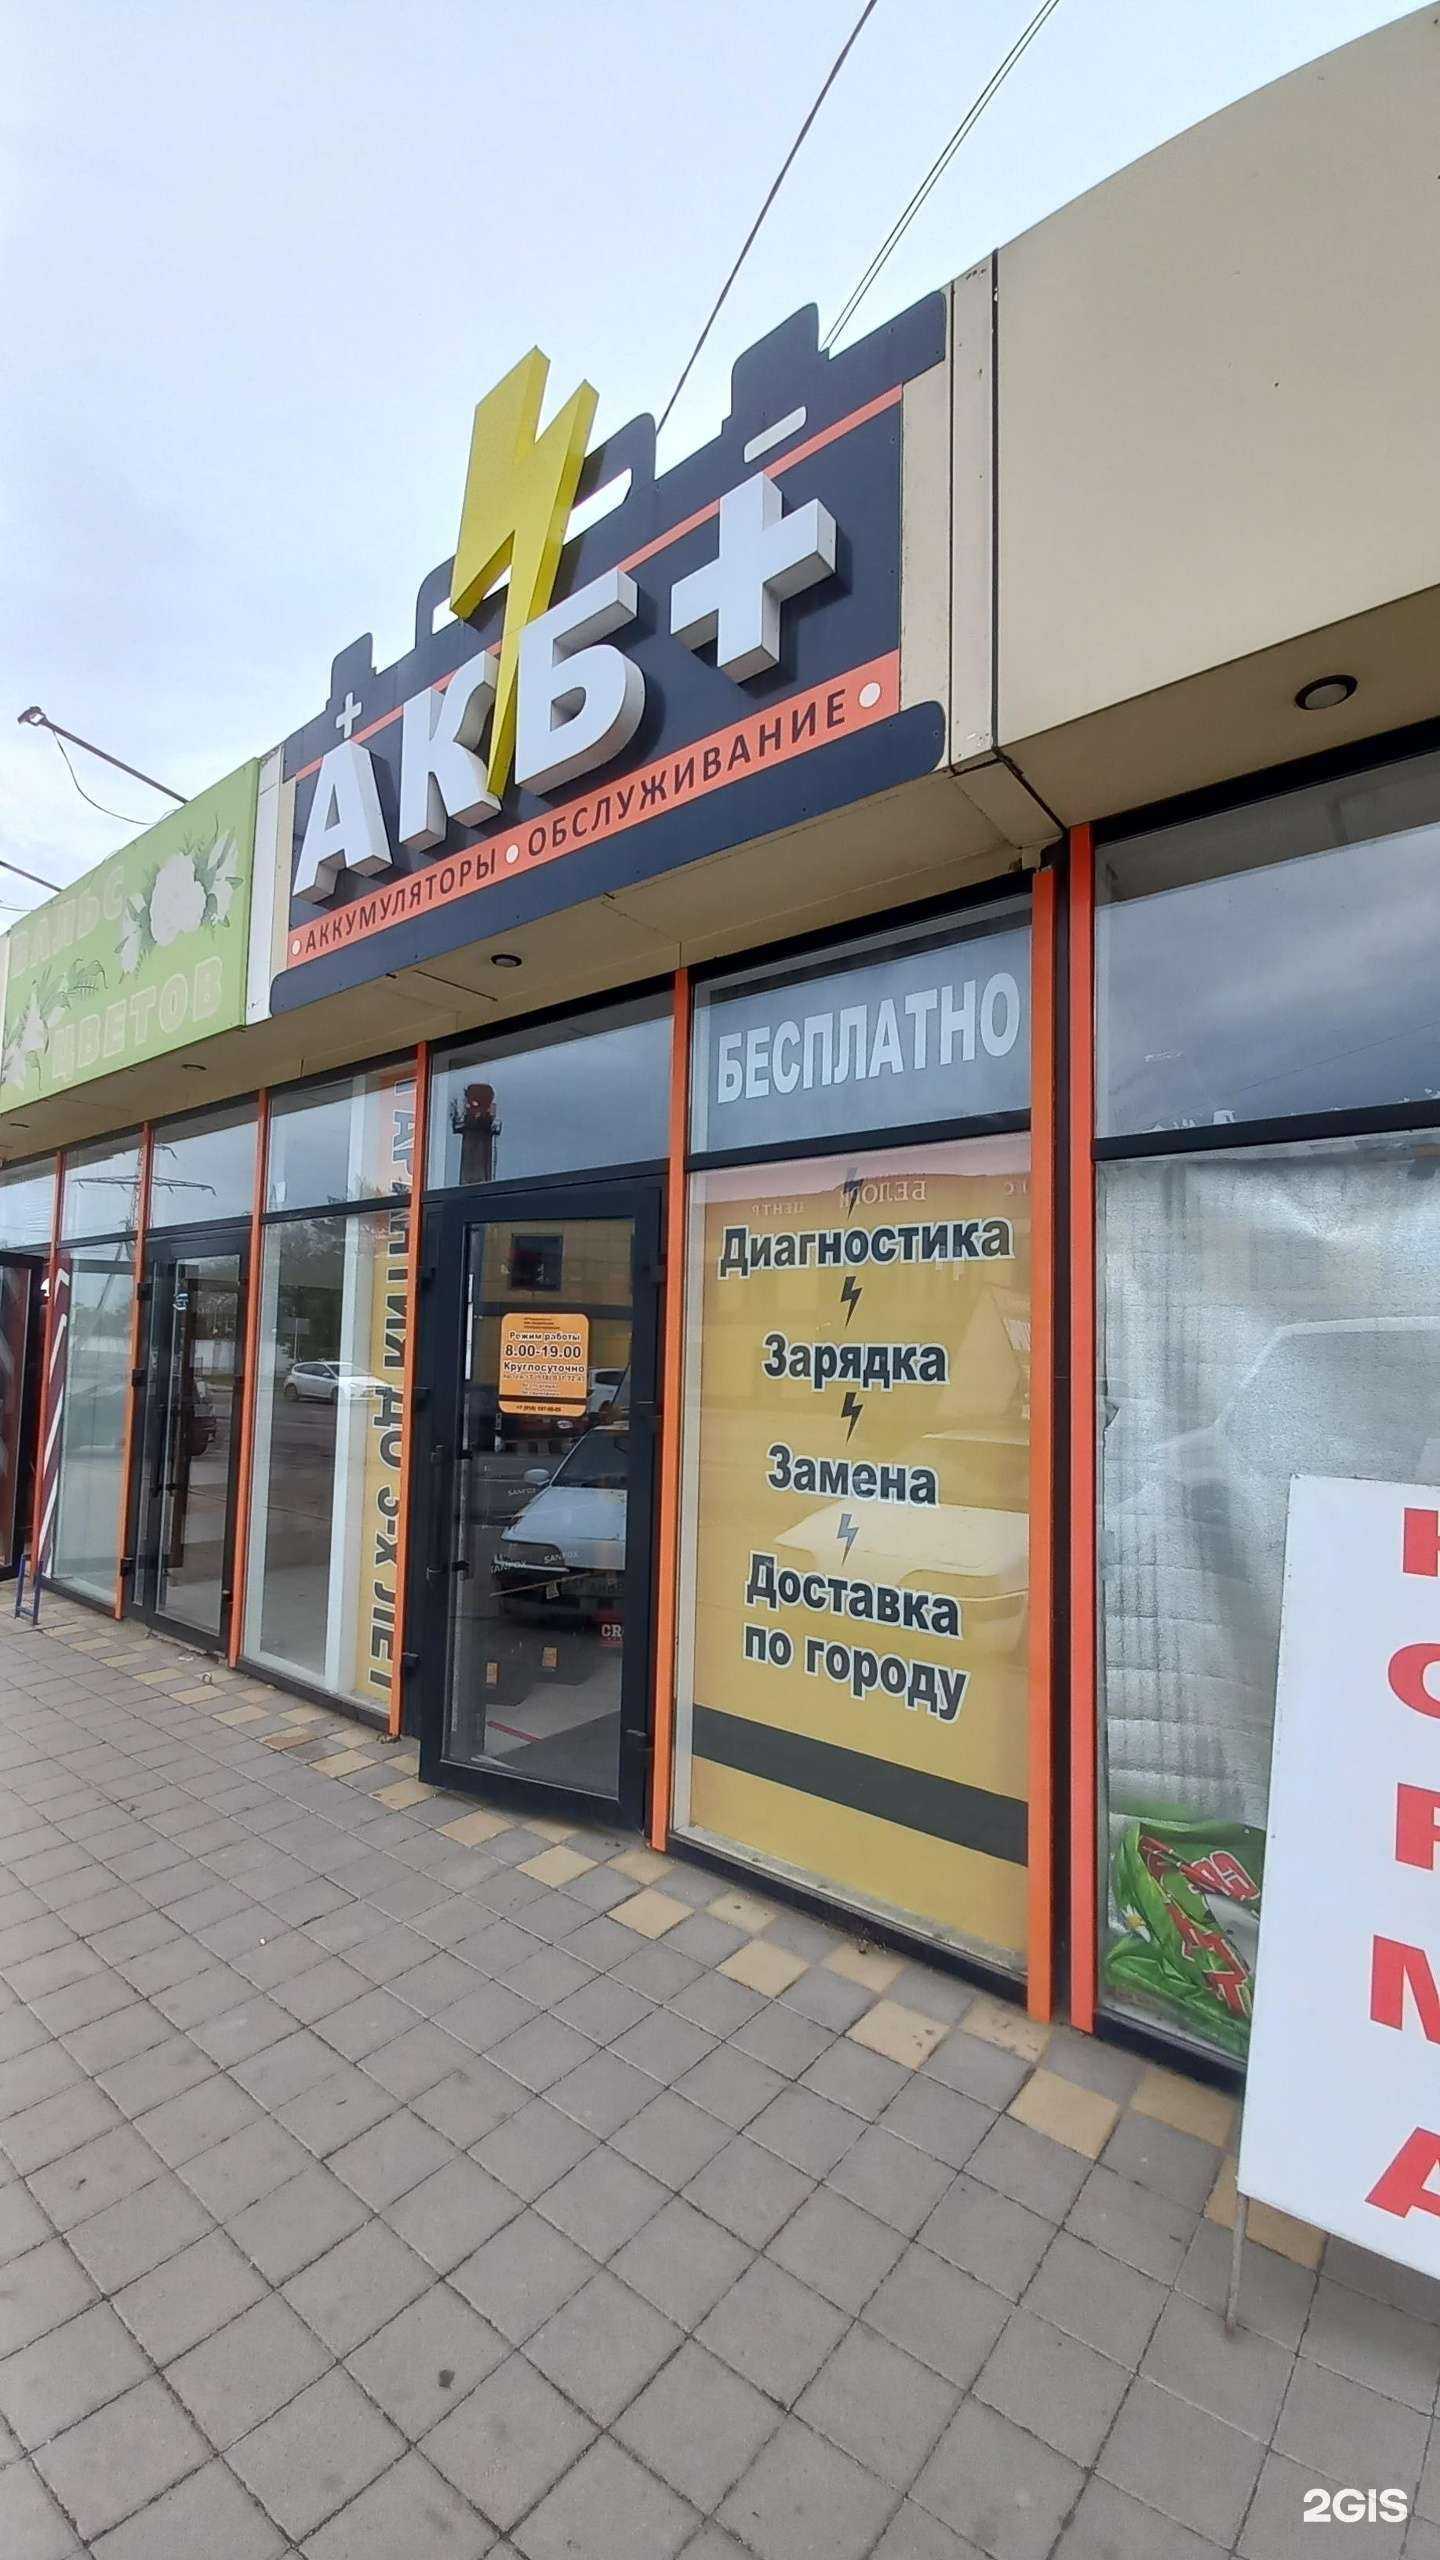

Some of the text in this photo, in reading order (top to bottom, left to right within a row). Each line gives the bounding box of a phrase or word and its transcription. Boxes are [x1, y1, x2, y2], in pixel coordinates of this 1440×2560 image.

[293, 568, 645, 901] АКБ
[305, 688, 847, 954] АККУМУЛЯТОРЫ ОБСЛУЖИВАНИЕ
[717, 972, 1021, 1104] БЕСПЛАТНО
[718, 1216, 1015, 1281] Диагностика
[504, 1361, 585, 1374] Круглосуточно
[505, 1344, 581, 1358] 8.00-19.00
[510, 1332, 580, 1341] Режим работы
[762, 1331, 949, 1391] Зарядка
[766, 1442, 938, 1508] Замена
[745, 1551, 963, 1639] Доставка
[743, 1623, 970, 1724] по городу
